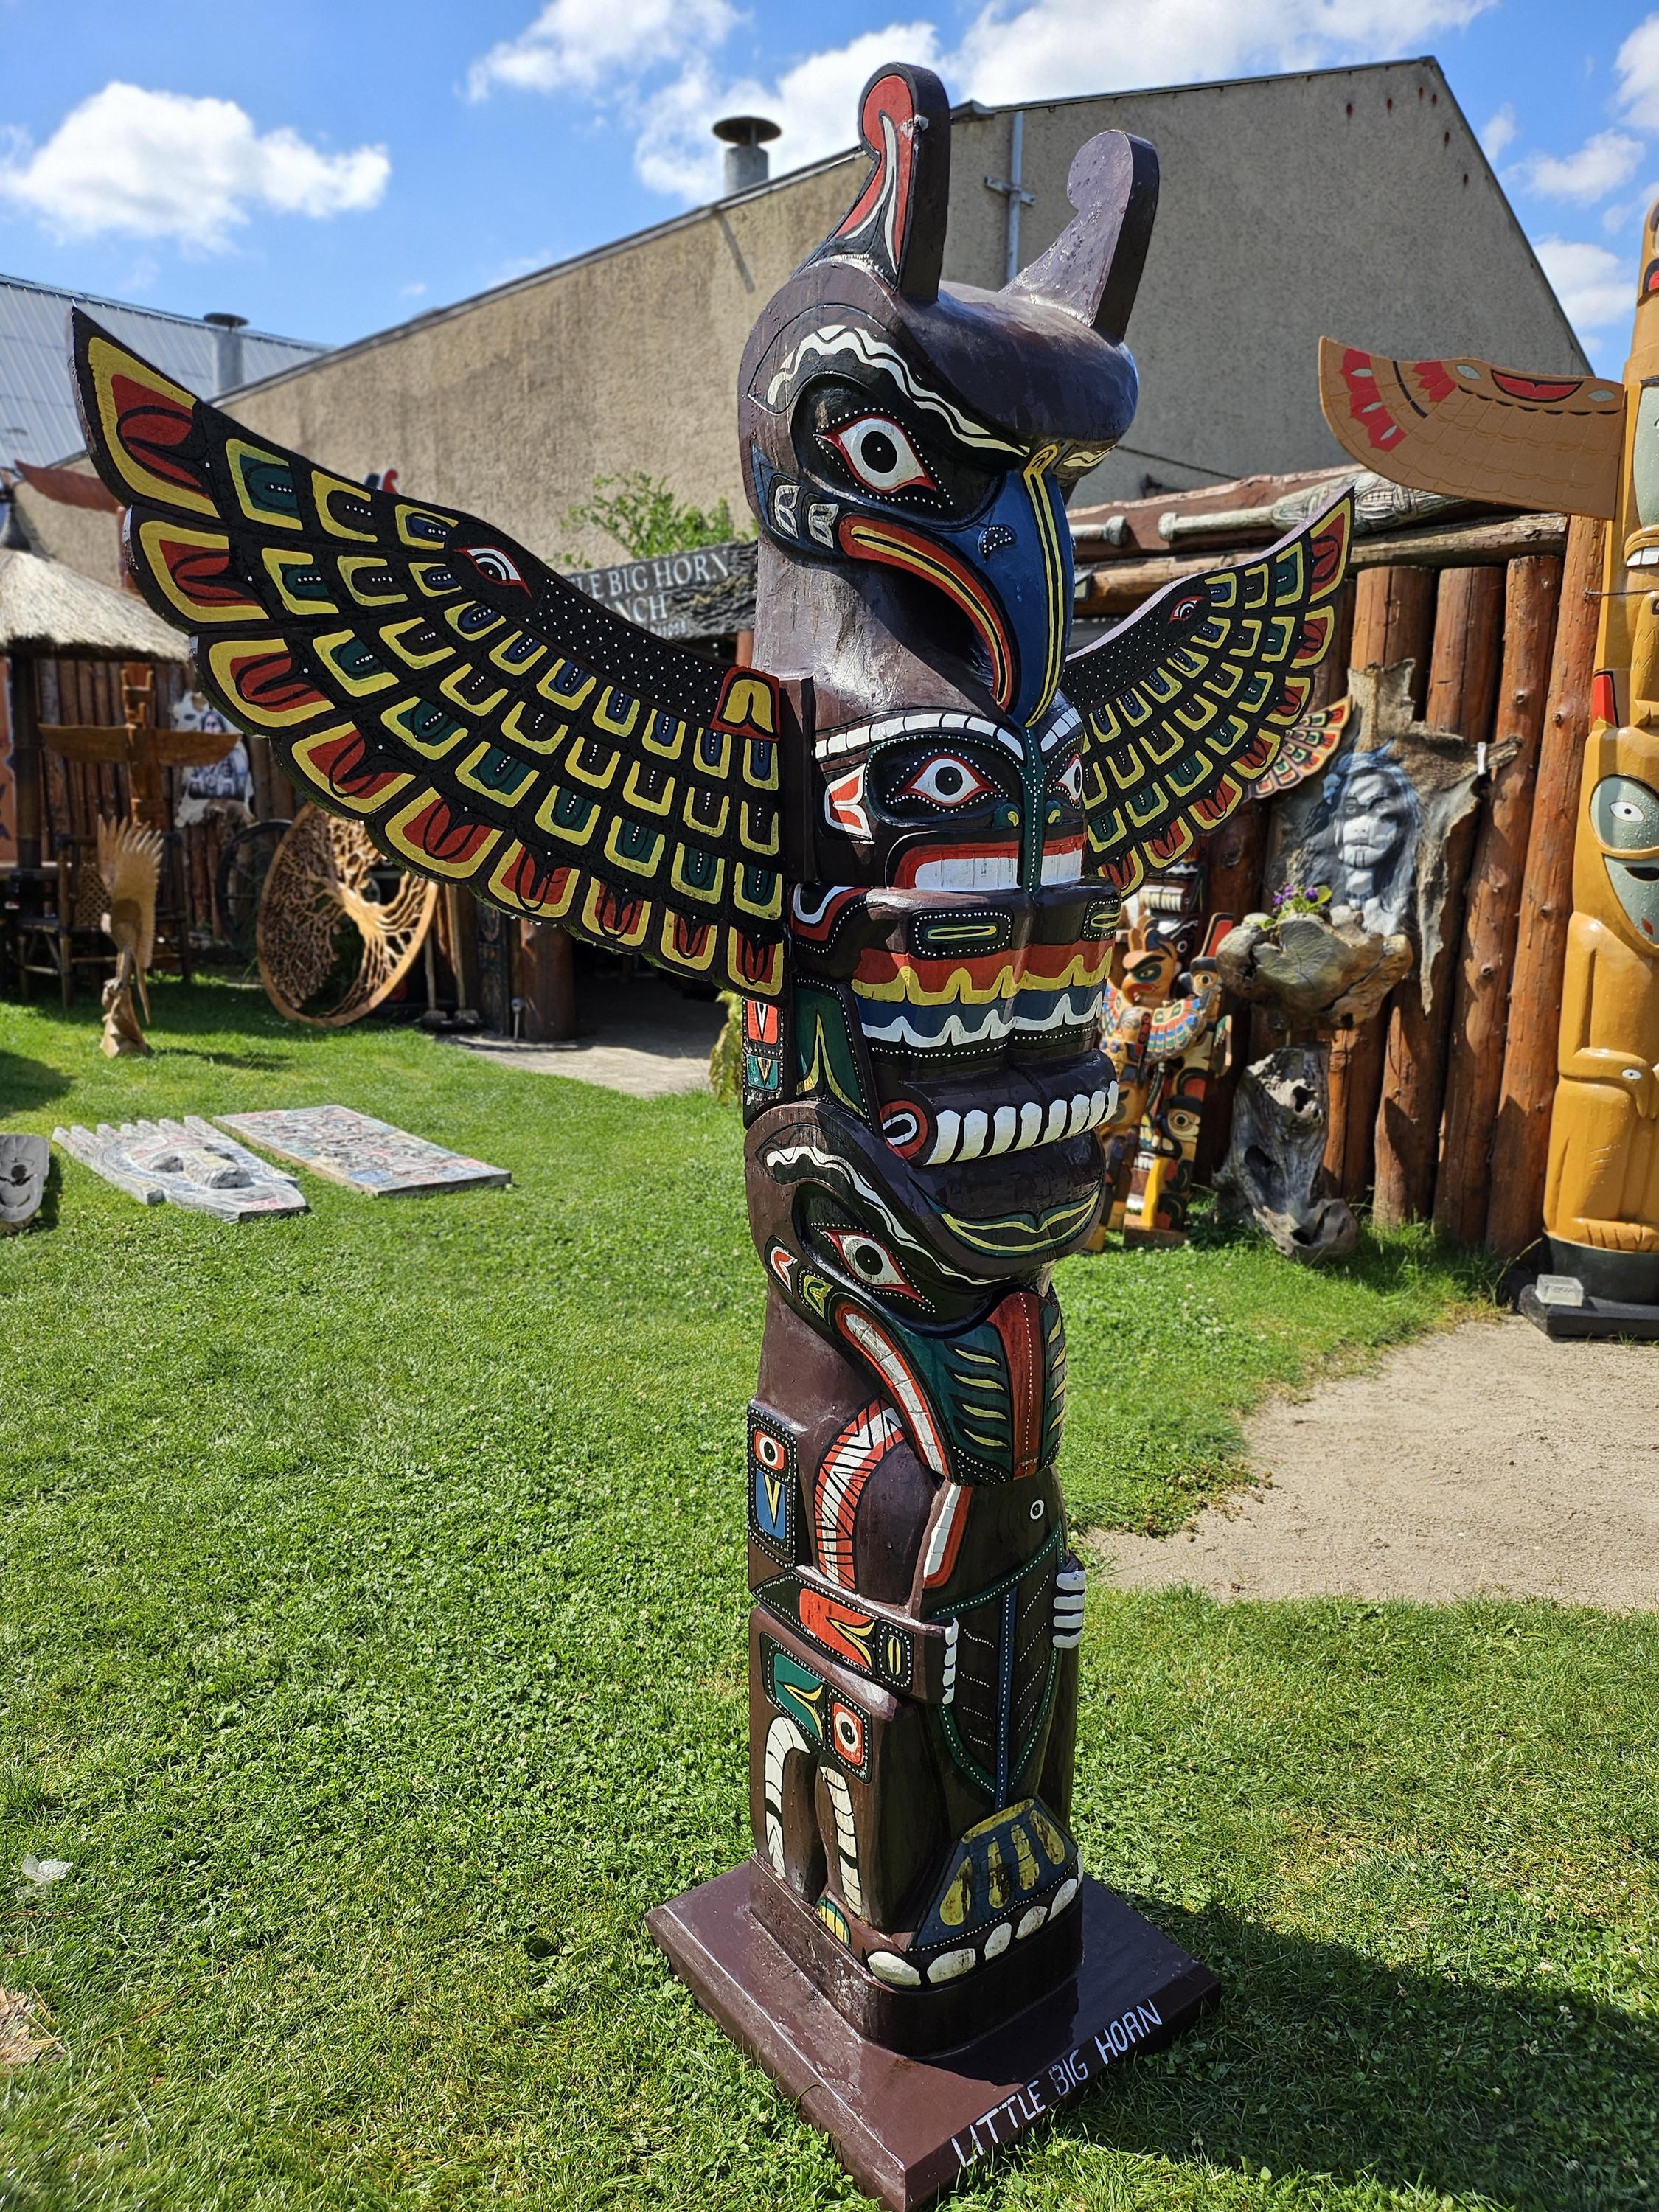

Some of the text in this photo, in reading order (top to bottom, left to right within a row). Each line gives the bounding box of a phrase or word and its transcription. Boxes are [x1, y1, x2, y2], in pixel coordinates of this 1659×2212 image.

[607, 566, 648, 597] BIG
[652, 550, 728, 588] HORN
[951, 1998, 1163, 2168] LITTLE BIG HORN
